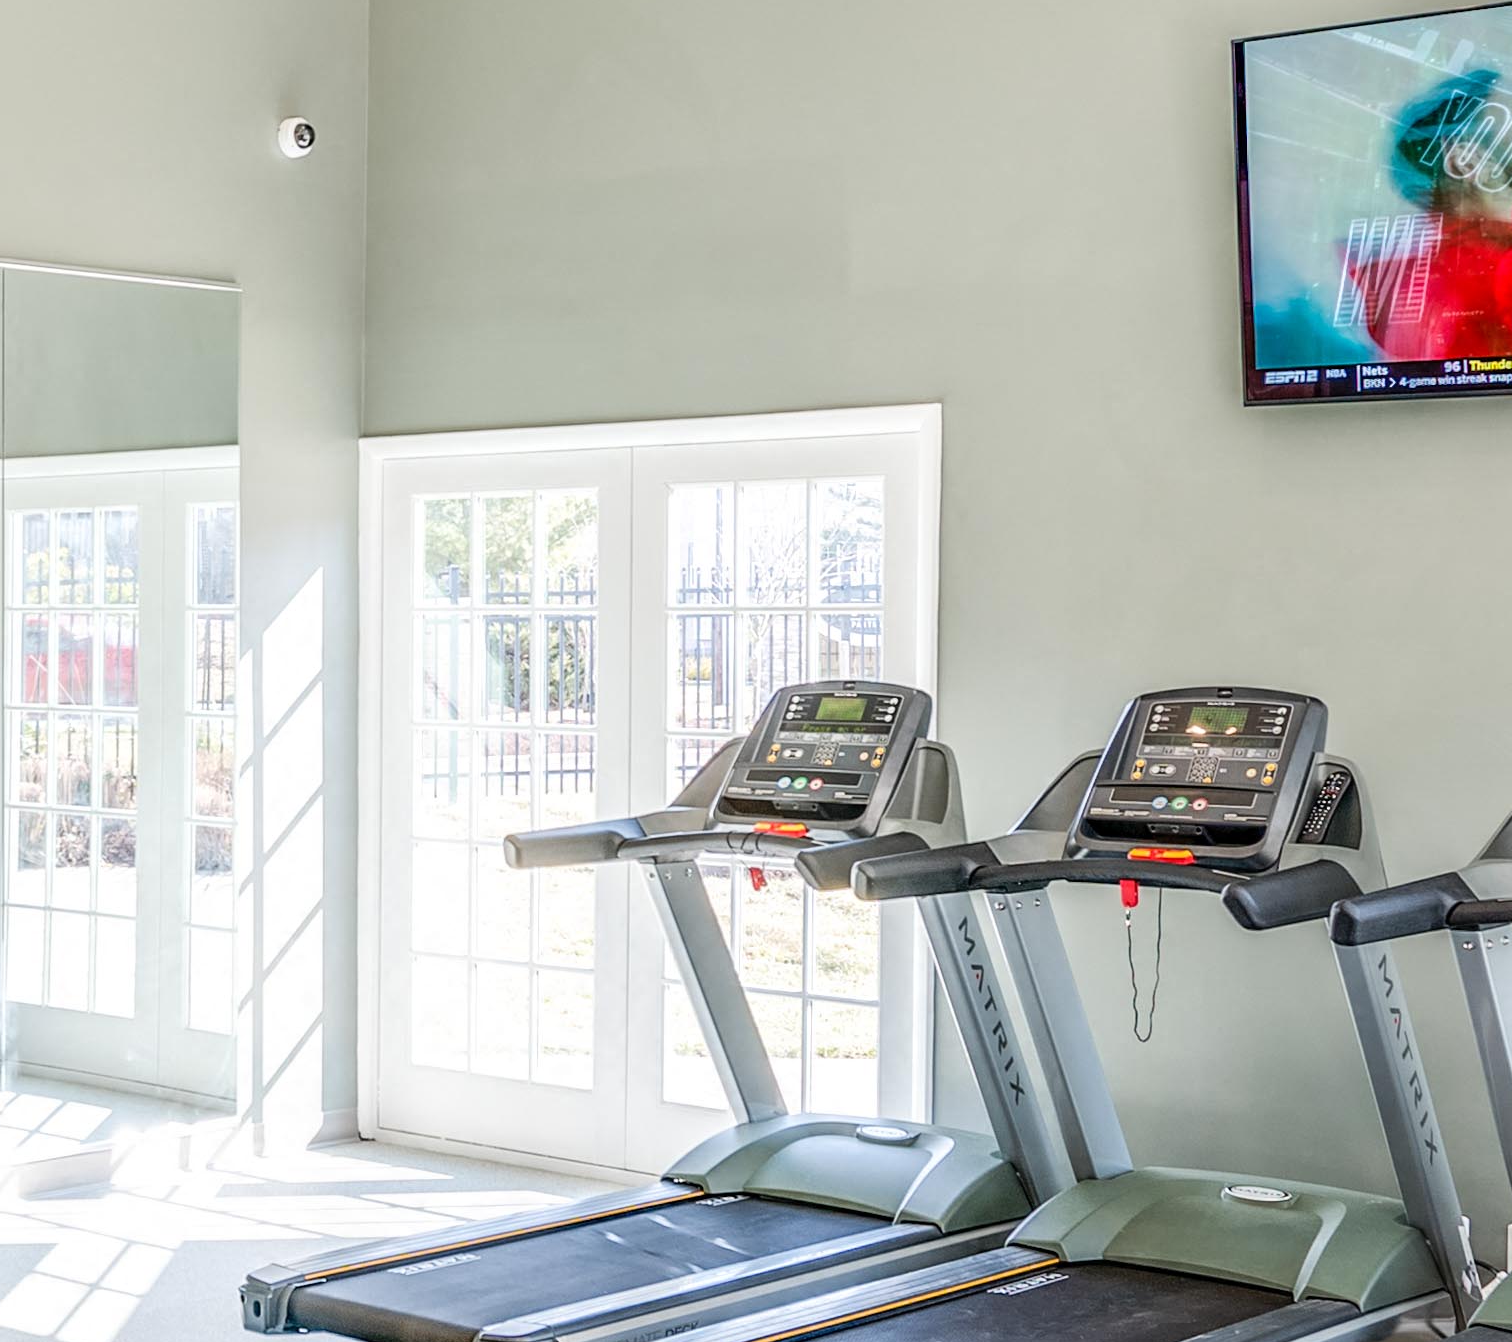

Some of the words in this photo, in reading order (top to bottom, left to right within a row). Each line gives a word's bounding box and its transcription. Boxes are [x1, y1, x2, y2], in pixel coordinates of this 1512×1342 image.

[1362, 365, 1388, 376] Nets
[1444, 361, 1461, 373] 96
[1457, 373, 1487, 385] streak
[958, 916, 1026, 1106] MATRIX
[1378, 953, 1438, 1166] MATRIX
